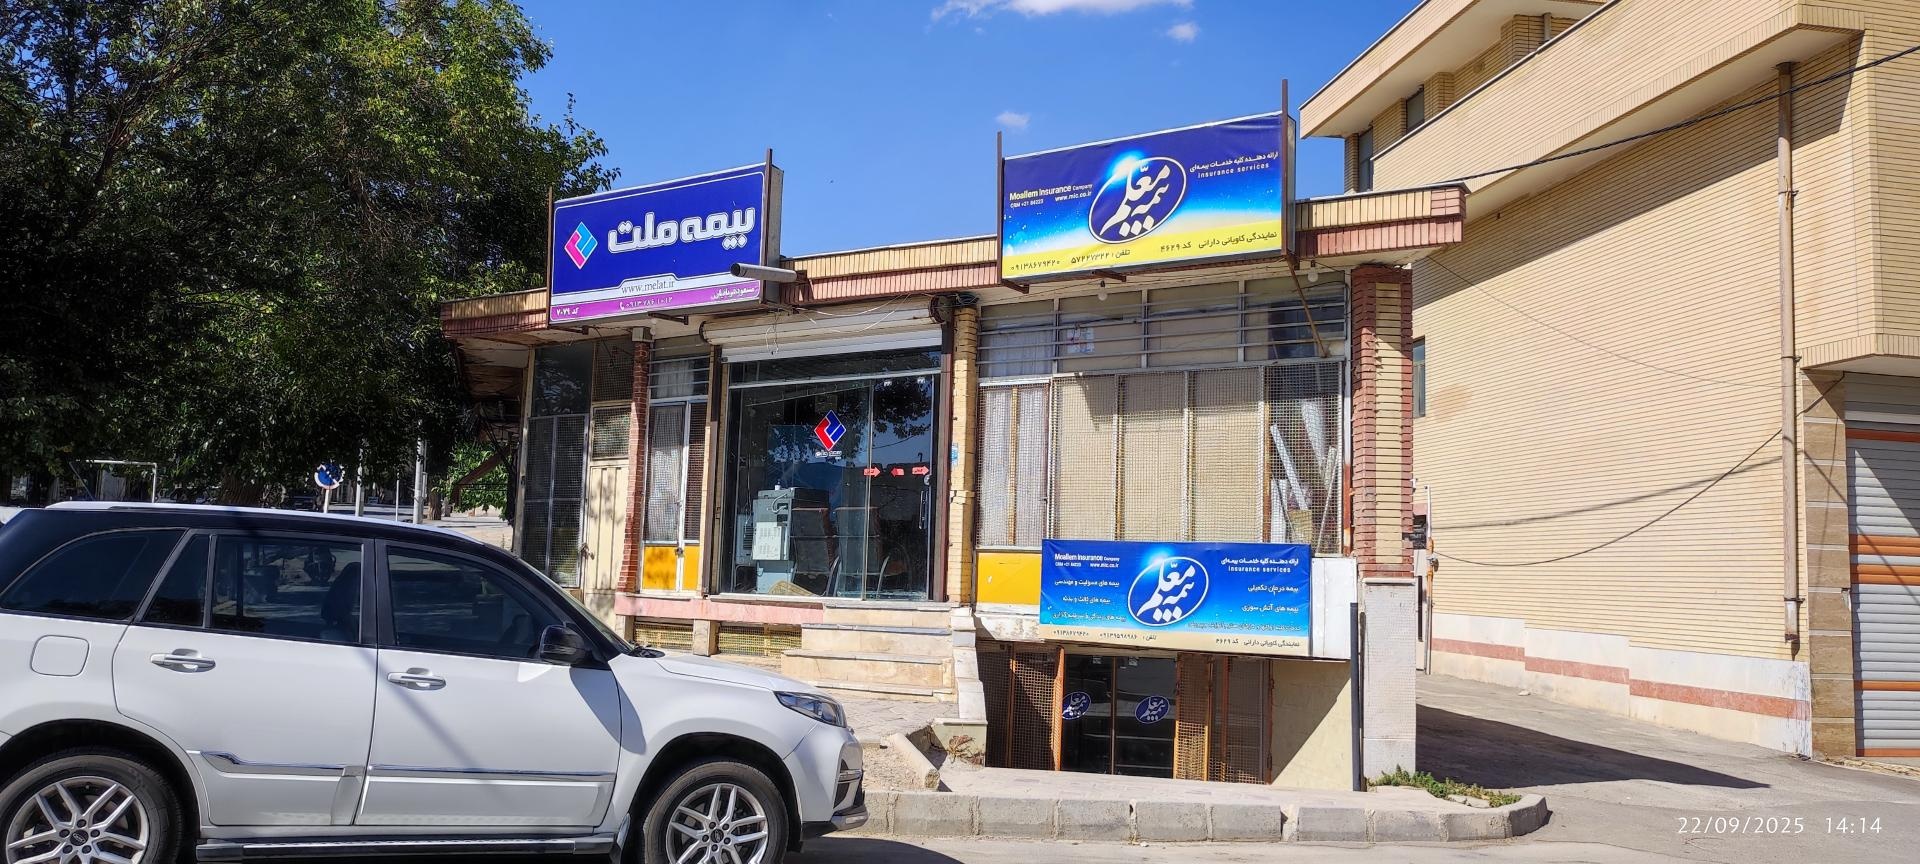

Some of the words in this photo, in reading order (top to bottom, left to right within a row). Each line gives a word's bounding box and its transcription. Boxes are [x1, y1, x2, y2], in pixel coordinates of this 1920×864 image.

[1198, 168, 1234, 179] insurance
[1237, 162, 1270, 173] services
[1009, 189, 1039, 201] Moallem
[1039, 185, 1072, 196] Insurance
[607, 211, 678, 254] ملت
[680, 207, 756, 250] بیمه
[1247, 231, 1277, 243] نمایندگی
[1183, 241, 1192, 249] کد
[621, 278, 675, 294] www.melat.ir
[1054, 553, 1077, 561] Moallem
[1247, 584, 1268, 592] تکمیلی
[1268, 585, 1285, 593] درمان
[1260, 603, 1273, 612] آتش
